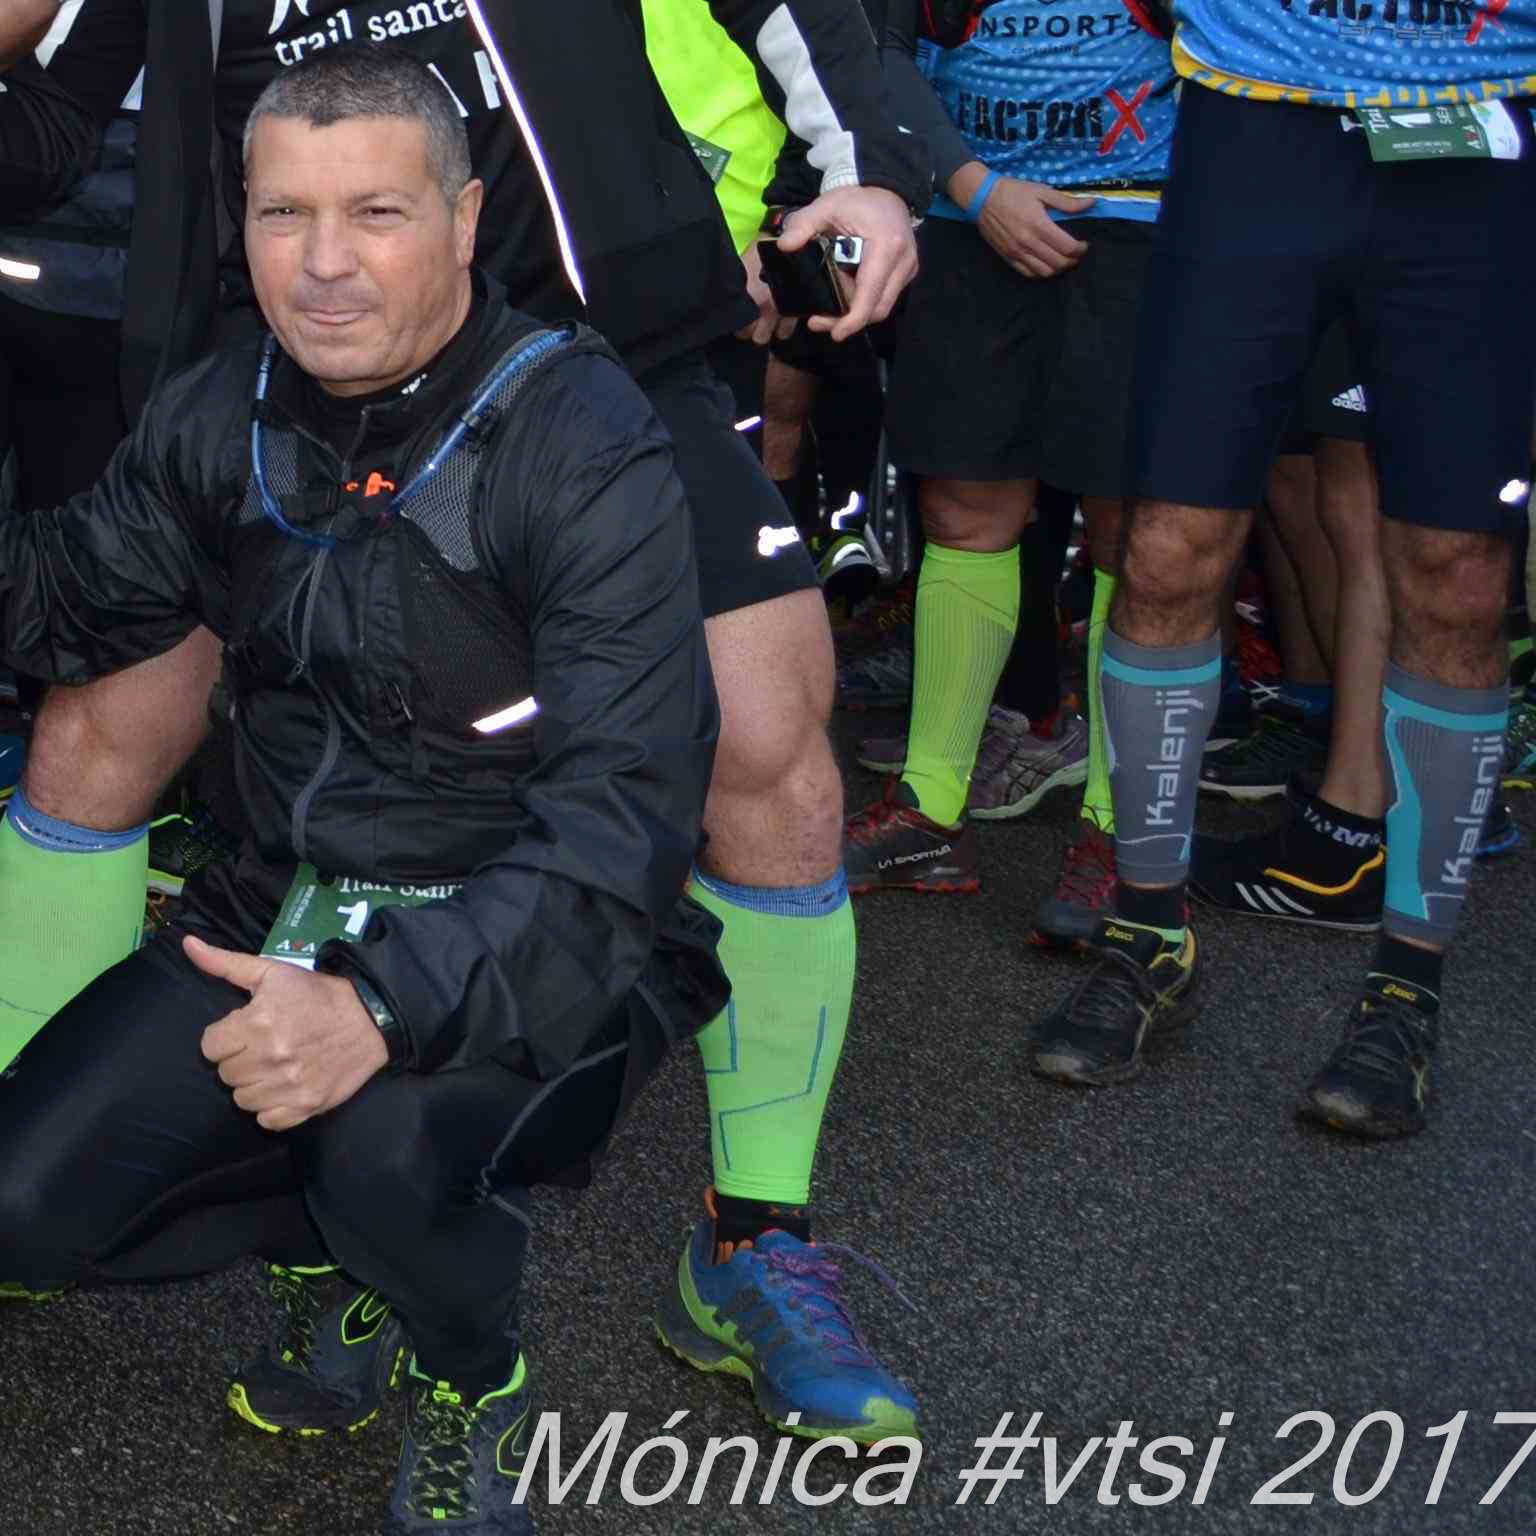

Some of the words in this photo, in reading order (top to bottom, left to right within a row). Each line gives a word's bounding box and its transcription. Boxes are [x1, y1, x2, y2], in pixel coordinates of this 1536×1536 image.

[274, 16, 355, 67] trail
[981, 13, 1141, 39] NSPORTS
[1144, 688, 1194, 828] Kalenji
[1440, 734, 1505, 887] Kalenji
